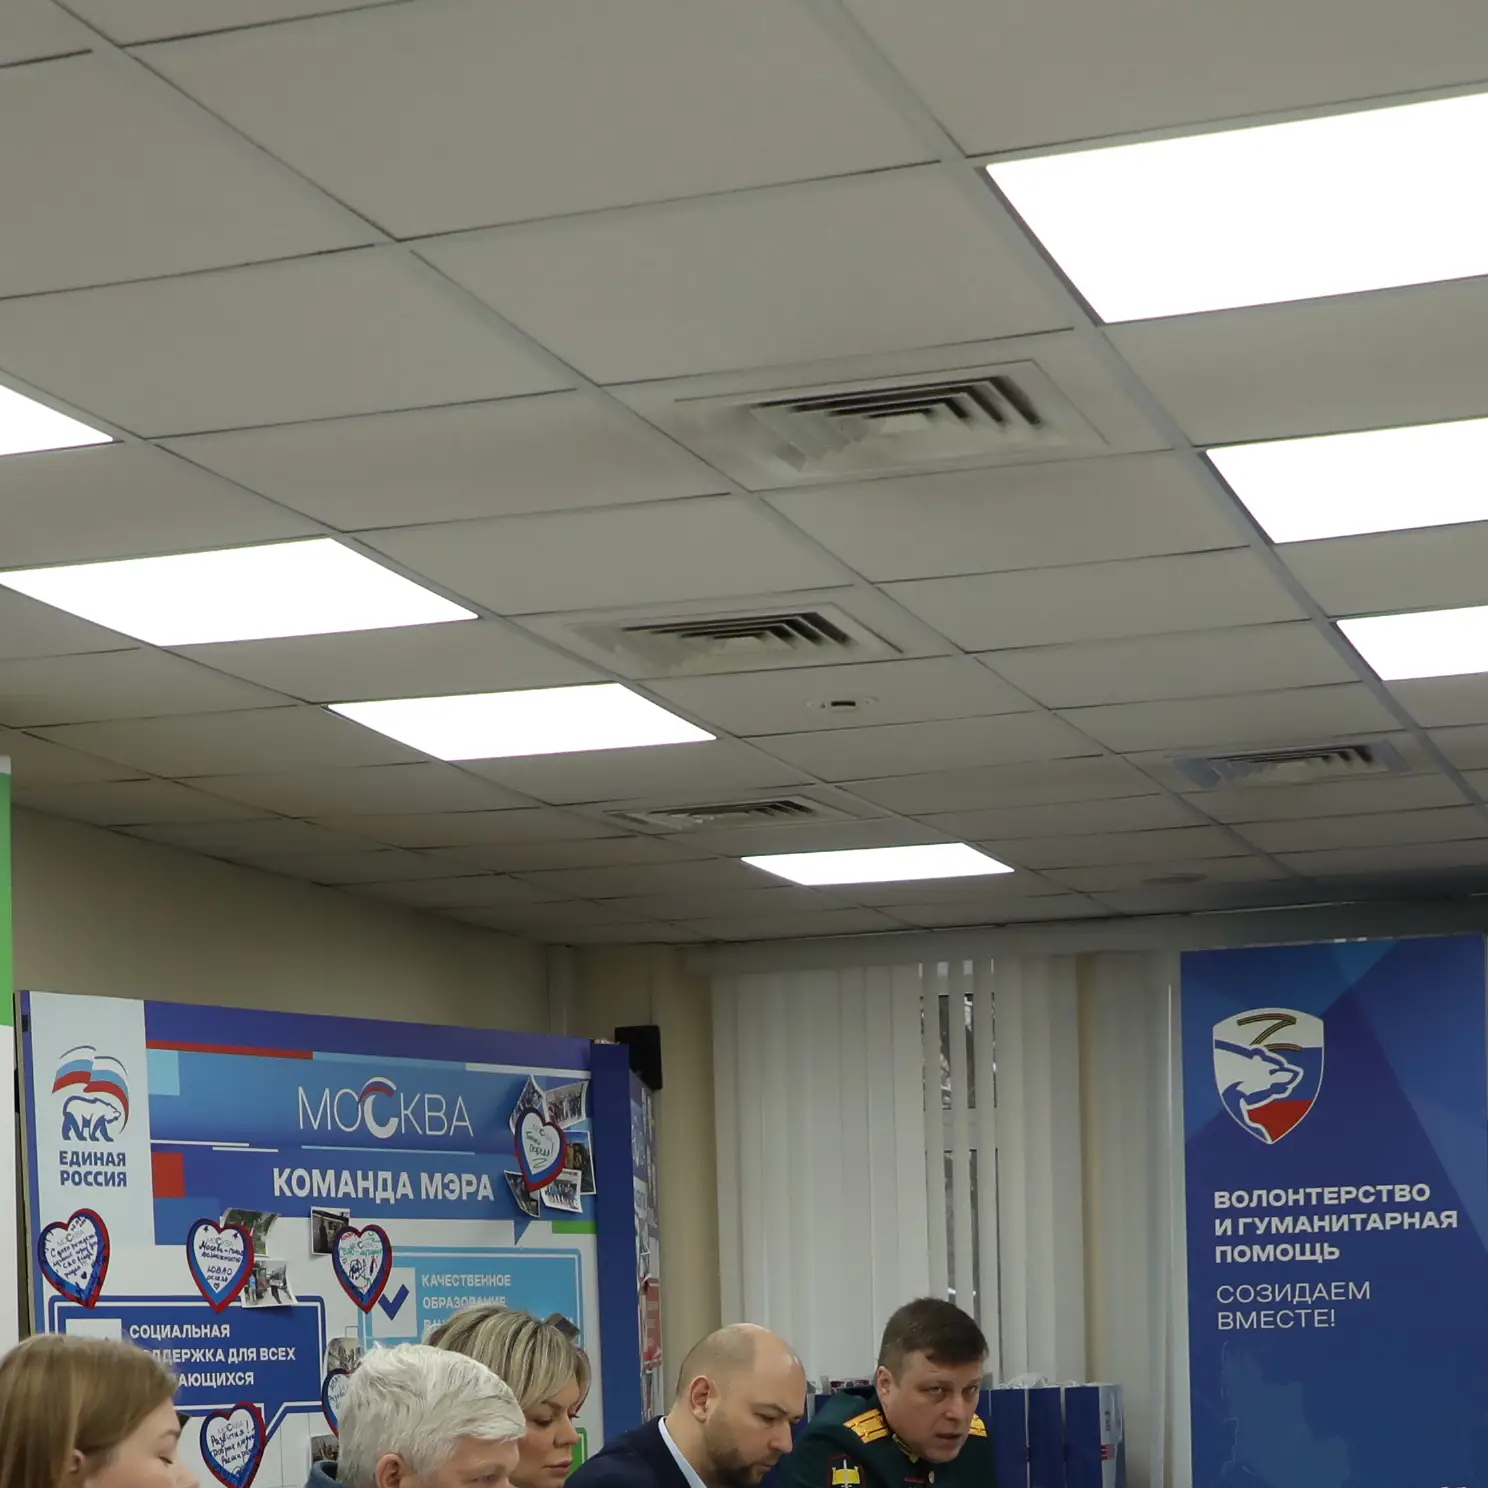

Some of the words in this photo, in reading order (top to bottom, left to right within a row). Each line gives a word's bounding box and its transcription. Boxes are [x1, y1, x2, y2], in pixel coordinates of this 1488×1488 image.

[297, 1076, 475, 1140] МОСКВА
[59, 1151, 126, 1168] ЕДИНАЯ
[60, 1170, 127, 1188] РОССИЯ
[272, 1167, 414, 1205] КОМАНДА
[420, 1172, 495, 1202] МЭРА
[1213, 1183, 1431, 1209] ВОЛОНТЕРСТВО
[1215, 1218, 1233, 1237] И
[1238, 1210, 1458, 1236] ГУМАНИТАРНАЯ
[1215, 1244, 1341, 1266] ПОМОЩЬ
[422, 1274, 511, 1287] КАЧЕСТВЕННОЕ
[1216, 1281, 1371, 1306] СОЗИДАЕМ
[1217, 1309, 1336, 1330] ВМЕСТЕ!
[129, 1324, 230, 1340] СОЦИАЛЬНАЯ
[144, 1349, 225, 1364] ДДЕРЖКА
[228, 1348, 256, 1364] ДЛЯ
[260, 1347, 296, 1360] ВСЕХ
[175, 1372, 254, 1388] АЮЩИХСЯ
